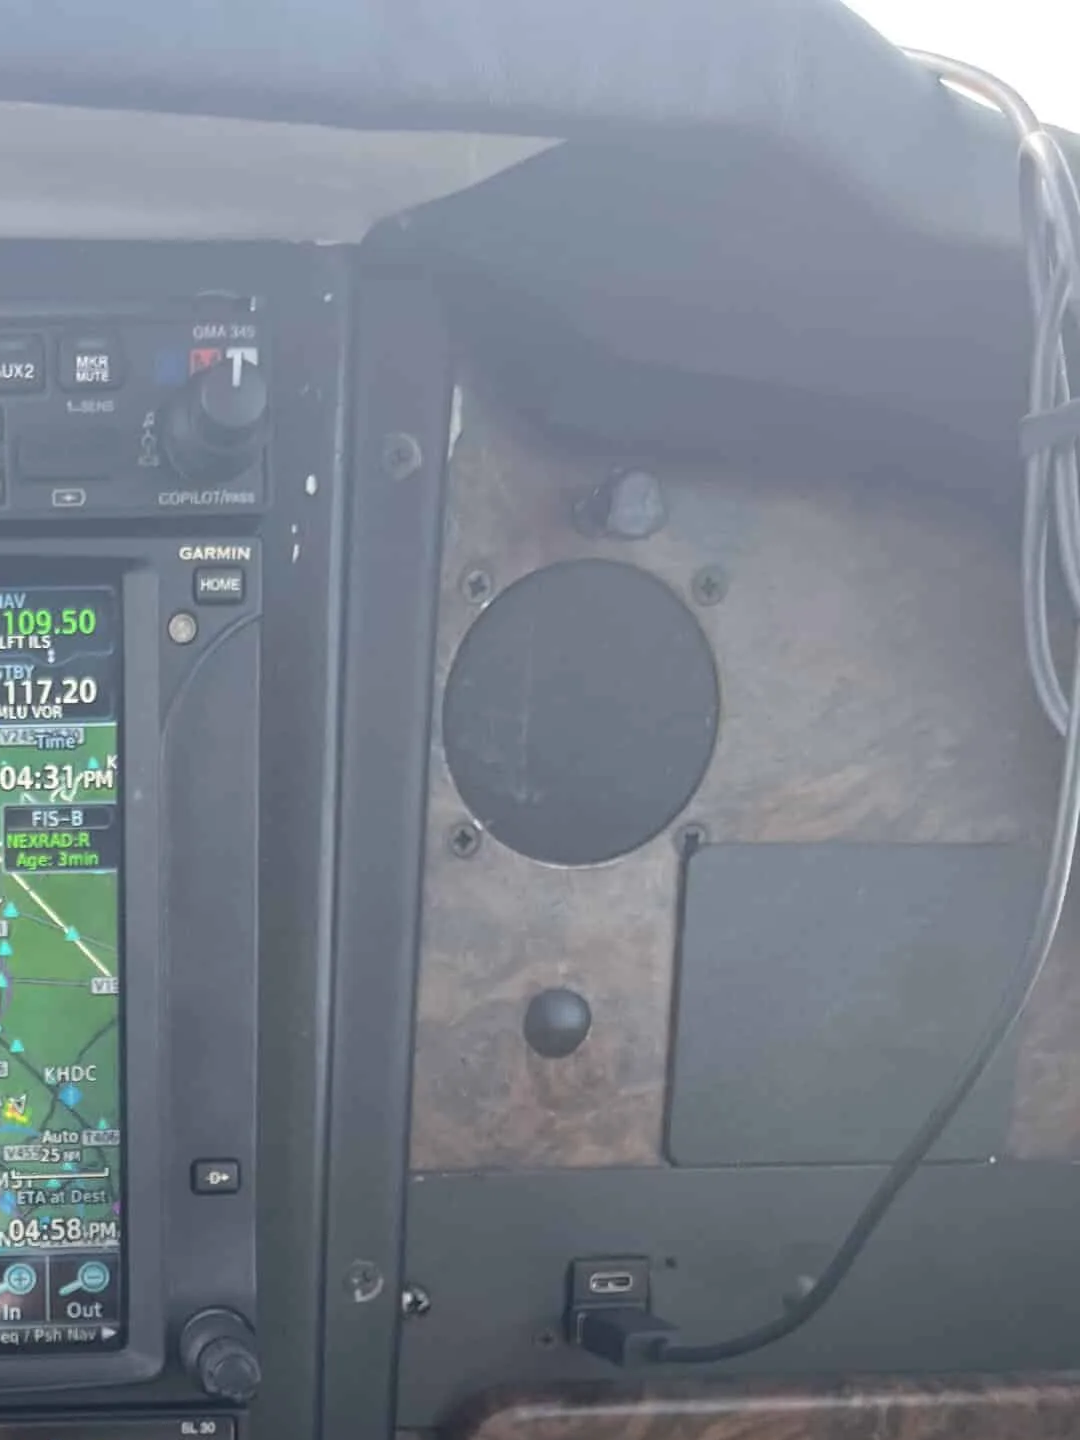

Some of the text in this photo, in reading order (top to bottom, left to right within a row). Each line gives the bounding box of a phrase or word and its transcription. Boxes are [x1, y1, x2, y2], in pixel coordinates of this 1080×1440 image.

[75, 356, 109, 369] MKR
[75, 369, 110, 382] MUTE
[178, 546, 251, 561] GARMIN
[199, 576, 241, 592] HOME
[1, 608, 96, 636] 109.50
[2, 677, 97, 705] 117.20
[31, 704, 63, 720] VOR
[0, 763, 113, 791] 04:31 PM
[44, 1065, 98, 1082] KHDC
[41, 1129, 79, 1144] Auto
[39, 1148, 61, 1163] 25
[17, 1191, 47, 1205] ETA
[8, 1218, 82, 1242] 04:58
[89, 1222, 117, 1240] PM
[2, 1304, 21, 1321] In
[66, 1301, 103, 1319] Out
[33, 1328, 63, 1343] Psh
[67, 1327, 97, 1342] Nav
